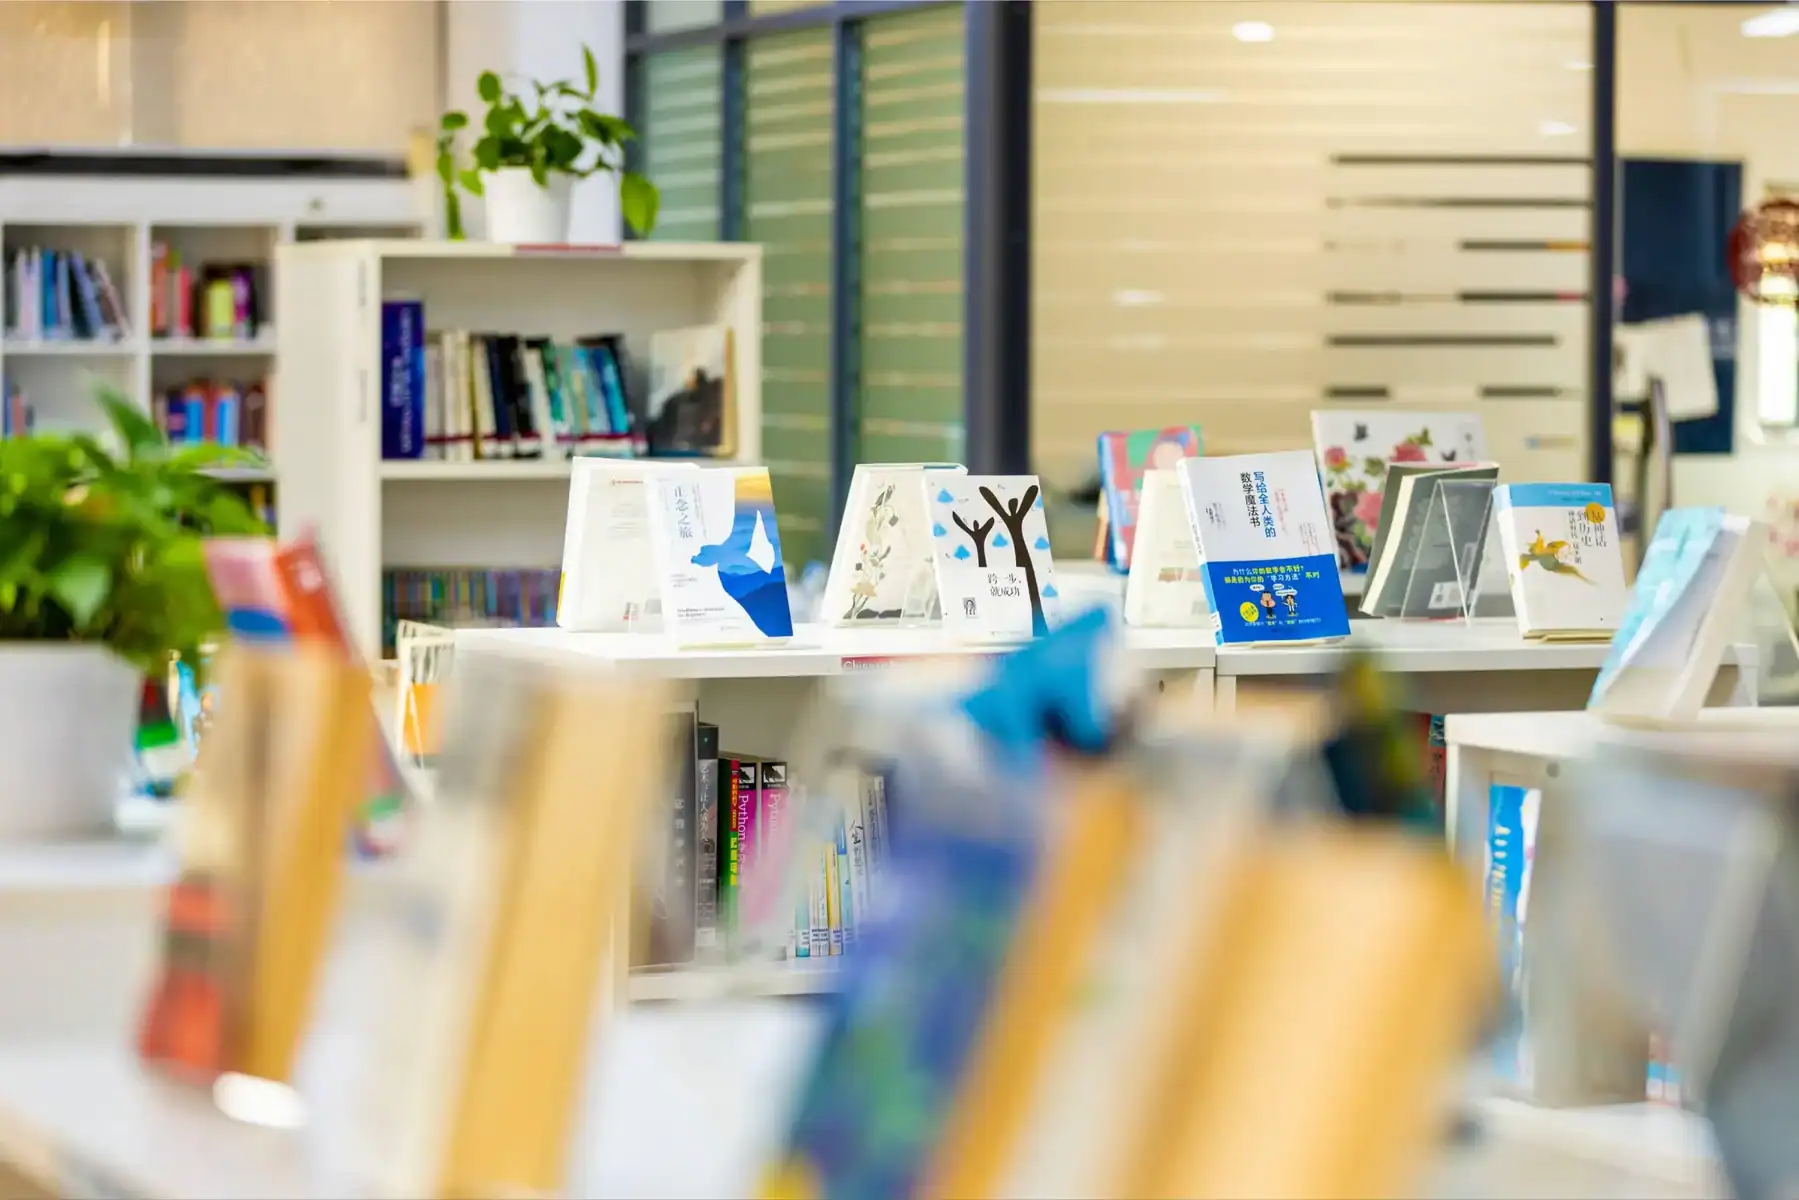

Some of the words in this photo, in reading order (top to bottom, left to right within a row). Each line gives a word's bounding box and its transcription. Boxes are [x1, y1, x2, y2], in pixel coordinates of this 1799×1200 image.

[673, 486, 693, 539] 正念之旅
[1240, 472, 1261, 528] 数学魔法书
[1253, 471, 1277, 539] 写给全人类的
[737, 793, 749, 841] Python
